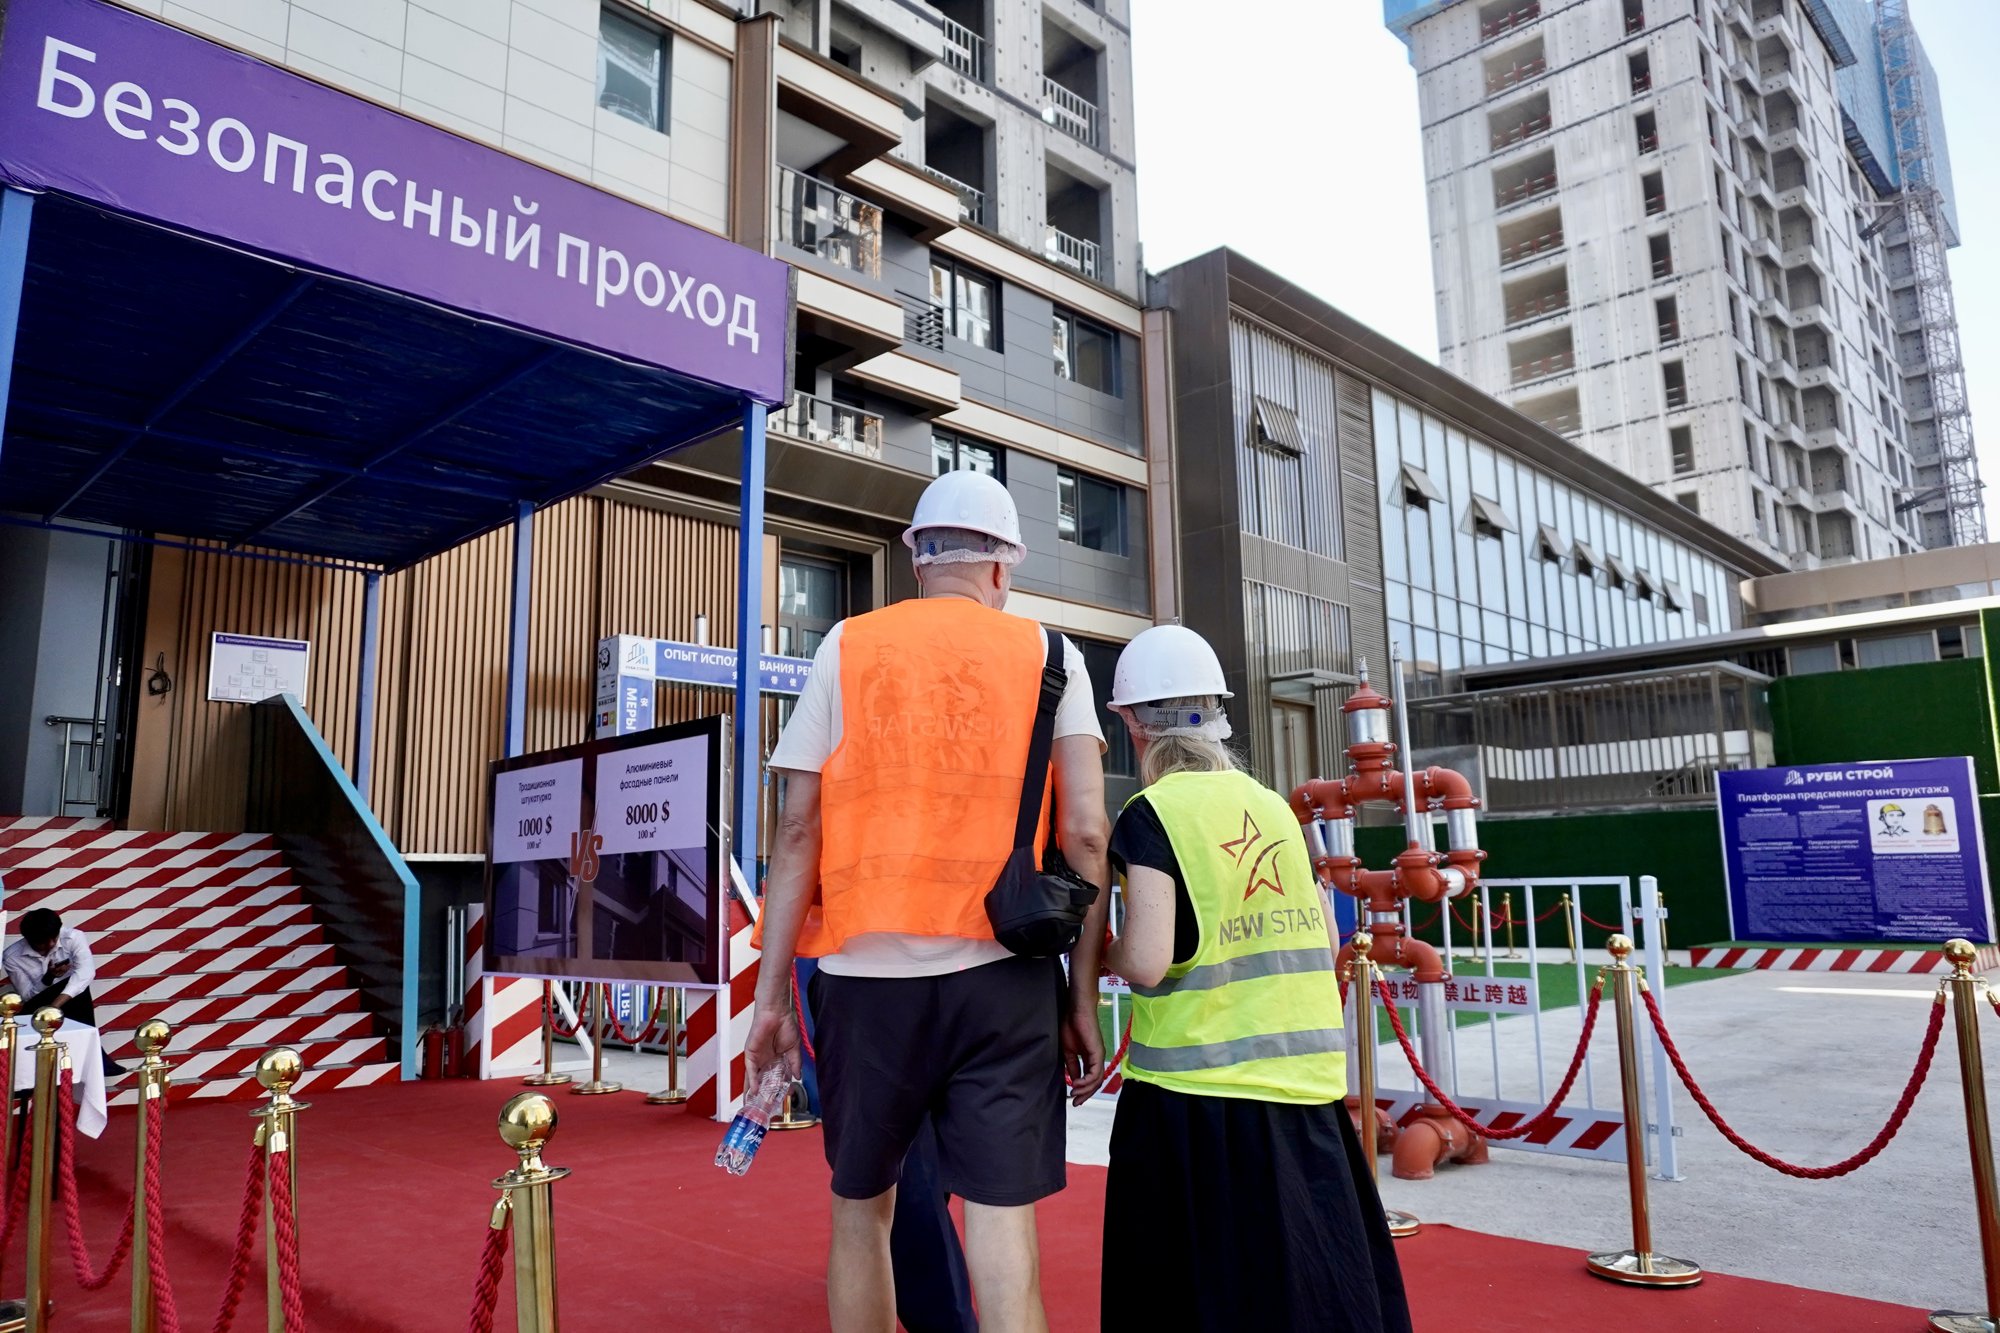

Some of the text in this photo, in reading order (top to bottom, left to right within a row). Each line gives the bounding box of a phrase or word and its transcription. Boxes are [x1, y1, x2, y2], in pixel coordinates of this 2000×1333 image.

[36, 36, 760, 354] Безопасный проход
[664, 648, 698, 663] ОПЫТ
[796, 664, 811, 676] РЕ
[626, 687, 638, 730] МЕРЫ
[626, 759, 673, 774] Алюминиевые
[1806, 766, 1894, 783] РУБИ СТРОЙ
[518, 779, 556, 792] Традиционная
[620, 773, 679, 791] фасадные панели
[520, 793, 552, 805] штукатурка
[1738, 785, 1950, 803] Платформа предсменного инструктажа
[626, 799, 670, 825] 8000 $
[518, 814, 552, 837] 1000 $
[638, 829, 648, 839] 100
[526, 841, 535, 850] 100
[570, 829, 603, 883] VS
[1219, 907, 1324, 946] NEW STAR
[1444, 982, 1528, 1006] 禁止跨越
